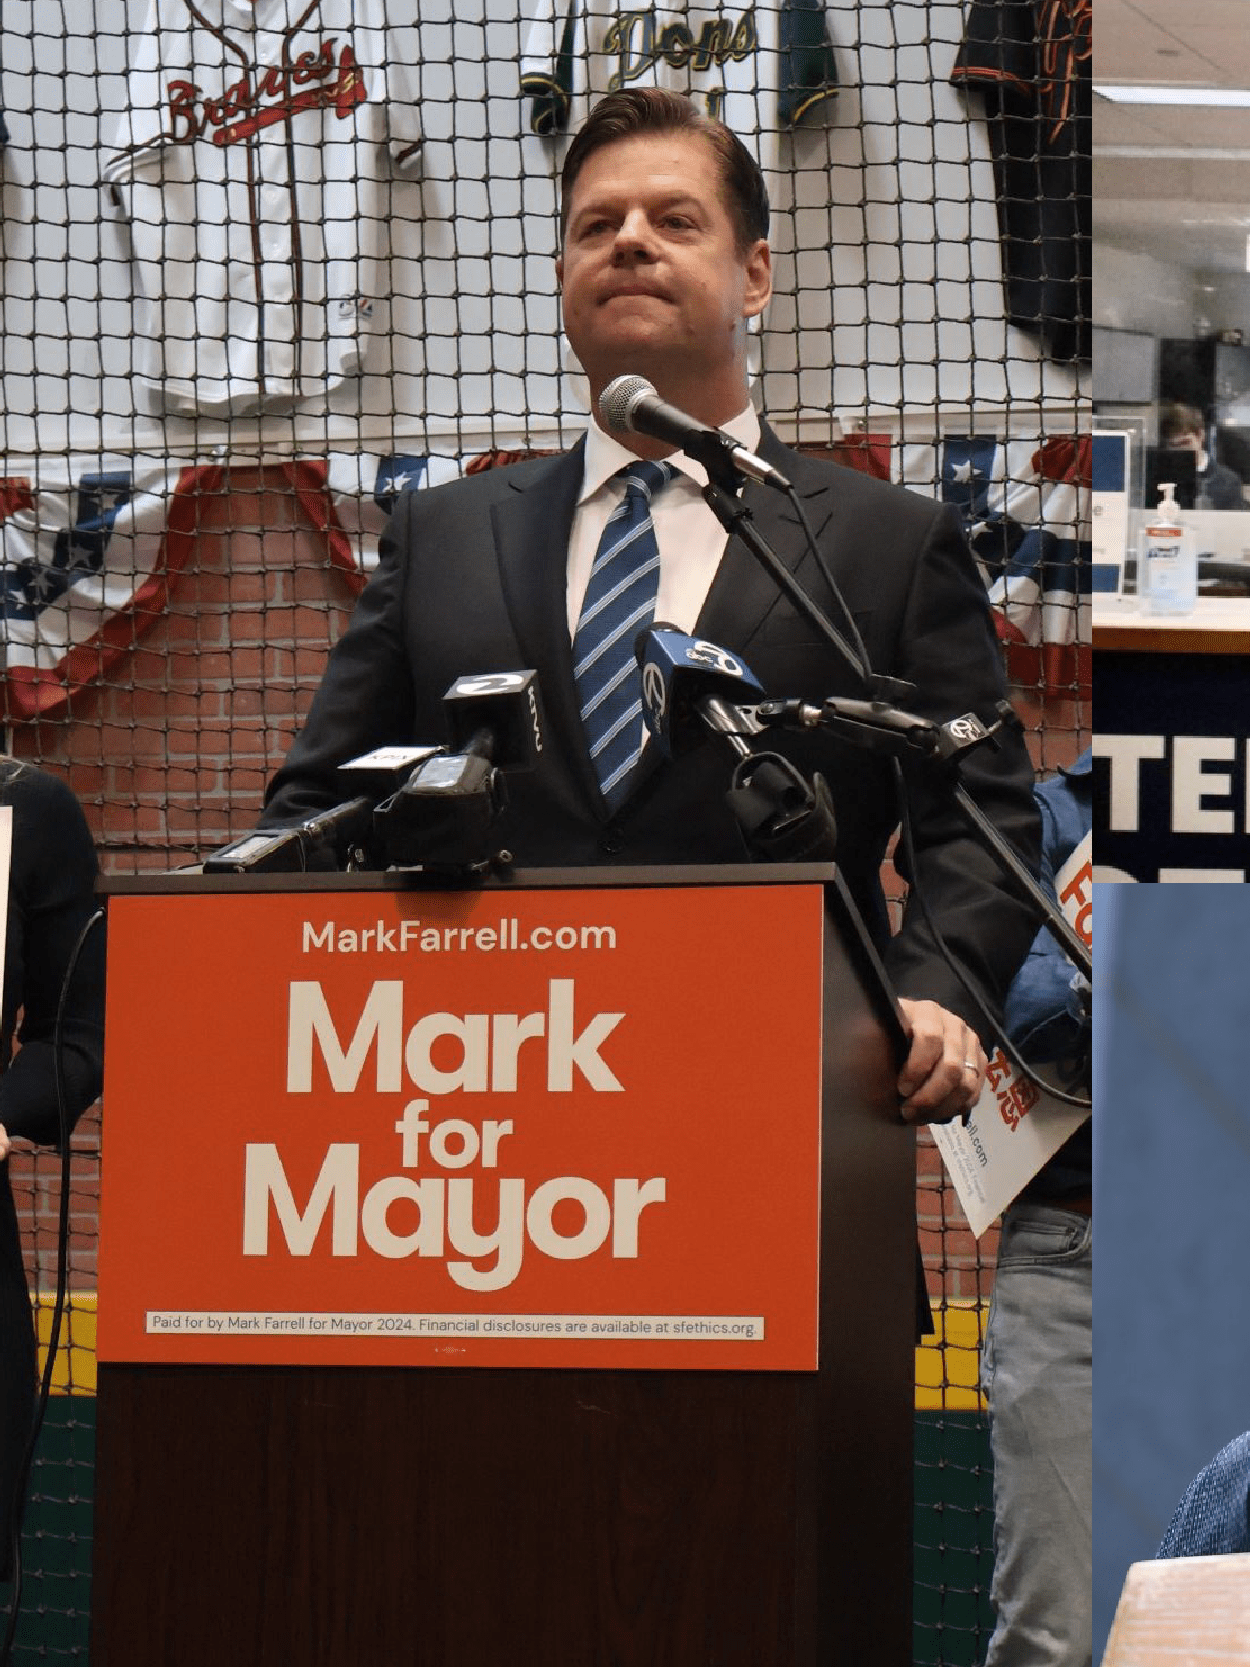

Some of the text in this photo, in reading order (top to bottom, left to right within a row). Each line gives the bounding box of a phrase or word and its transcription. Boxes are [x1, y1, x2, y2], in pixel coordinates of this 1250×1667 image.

[167, 37, 338, 142] Braves
[455, 674, 525, 695] 2
[303, 919, 616, 953] MarkFarrell.com
[287, 979, 626, 1095] Mark
[396, 1099, 514, 1168] for
[243, 1144, 666, 1292] Mayor
[152, 1315, 181, 1329] Paid
[185, 1316, 204, 1329] for
[206, 1316, 223, 1331] by
[228, 1316, 260, 1329] Mark
[264, 1316, 305, 1330] Farrell
[309, 1317, 328, 1330] for
[331, 1318, 373, 1334] Mayor
[376, 1318, 416, 1331] 2024.
[420, 1318, 480, 1332] Financial
[483, 1319, 561, 1332] disclosures
[565, 1321, 588, 1333] are
[591, 1320, 652, 1333] available
[656, 1321, 669, 1333] at
